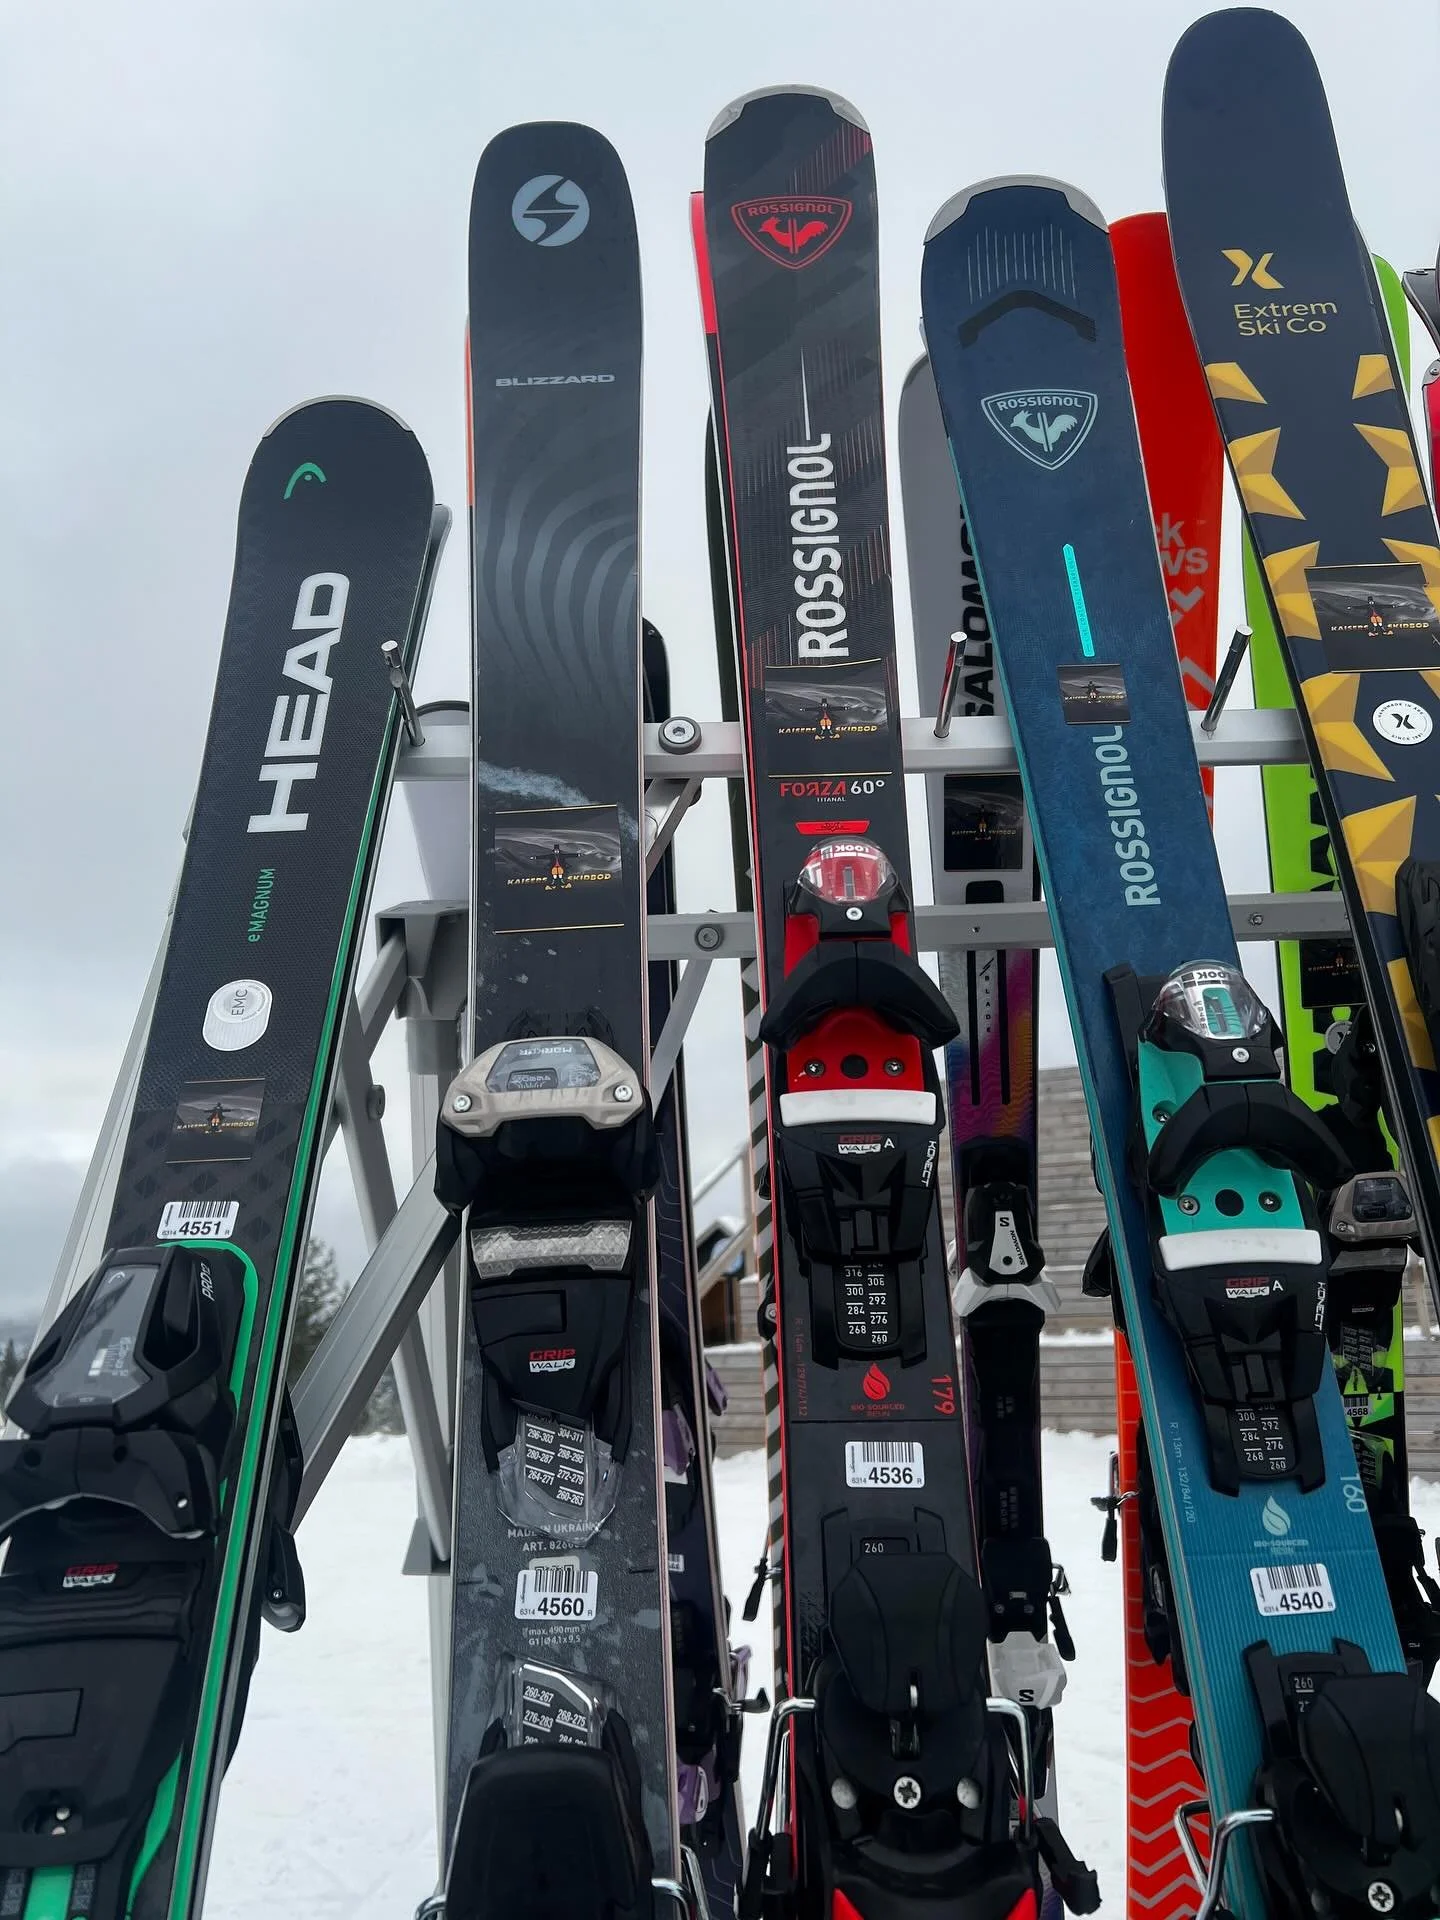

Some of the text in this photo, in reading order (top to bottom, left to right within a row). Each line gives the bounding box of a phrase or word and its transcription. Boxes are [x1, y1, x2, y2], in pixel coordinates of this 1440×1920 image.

[749, 200, 836, 217] ROSSIGNOL
[1233, 301, 1337, 320] Extrem
[1238, 317, 1327, 337] Ski Co
[495, 373, 616, 388] BLIZZARD
[996, 395, 1083, 411] ROSSIGNOL
[786, 433, 849, 658] ROSSIGNOL
[247, 572, 350, 833] HEAD
[1092, 725, 1162, 907] ROSSIGNOL
[248, 868, 276, 943] eMAGNUM
[231, 988, 248, 1016] EMC
[840, 1135, 881, 1143] GRIP
[884, 1137, 895, 1149] A
[839, 1144, 880, 1152] WALK
[920, 1140, 937, 1187] KONECT
[179, 1221, 221, 1236] 4551
[1010, 1229, 1025, 1265] SALOMON
[845, 1269, 863, 1277] 316
[1225, 1277, 1270, 1287] GRIP
[1272, 1280, 1284, 1292] A
[846, 1287, 864, 1296] 300
[1226, 1287, 1268, 1297] WALK
[868, 1296, 886, 1305] 292
[1314, 1281, 1327, 1331] KONECT
[848, 1306, 865, 1315] 284
[870, 1315, 888, 1325] 276
[849, 1325, 867, 1335] 268
[871, 1334, 888, 1344] 260
[529, 1349, 576, 1361] GRIP
[531, 1359, 575, 1369] WALK
[932, 1374, 955, 1415] 179
[1238, 1412, 1255, 1421] 300
[1347, 1407, 1369, 1417] 4568
[1261, 1421, 1279, 1430] 292
[528, 1429, 554, 1444] 296-303
[558, 1427, 583, 1443] 304-311
[1242, 1432, 1260, 1441] 284
[1265, 1441, 1283, 1450] 276
[527, 1449, 554, 1464] 280-287
[558, 1448, 584, 1463] 288-295
[1246, 1452, 1263, 1461] 268
[1270, 1461, 1286, 1470] 260
[528, 1470, 555, 1485] 264-271
[557, 1469, 584, 1484] 272-279
[868, 1467, 913, 1484] 4536
[557, 1490, 583, 1506] 260-263
[1178, 1467, 1195, 1524] 132/84/120
[1340, 1476, 1368, 1513] 160
[522, 1541, 547, 1552] ART.
[864, 1543, 884, 1553] 260
[538, 1598, 584, 1616] 4560
[1280, 1592, 1323, 1611] 4540
[1294, 1677, 1313, 1688] 260
[524, 1686, 554, 1702] 260-267
[1019, 1689, 1035, 1702] S
[524, 1710, 553, 1728] 276-283
[556, 1709, 586, 1727] 268-275
